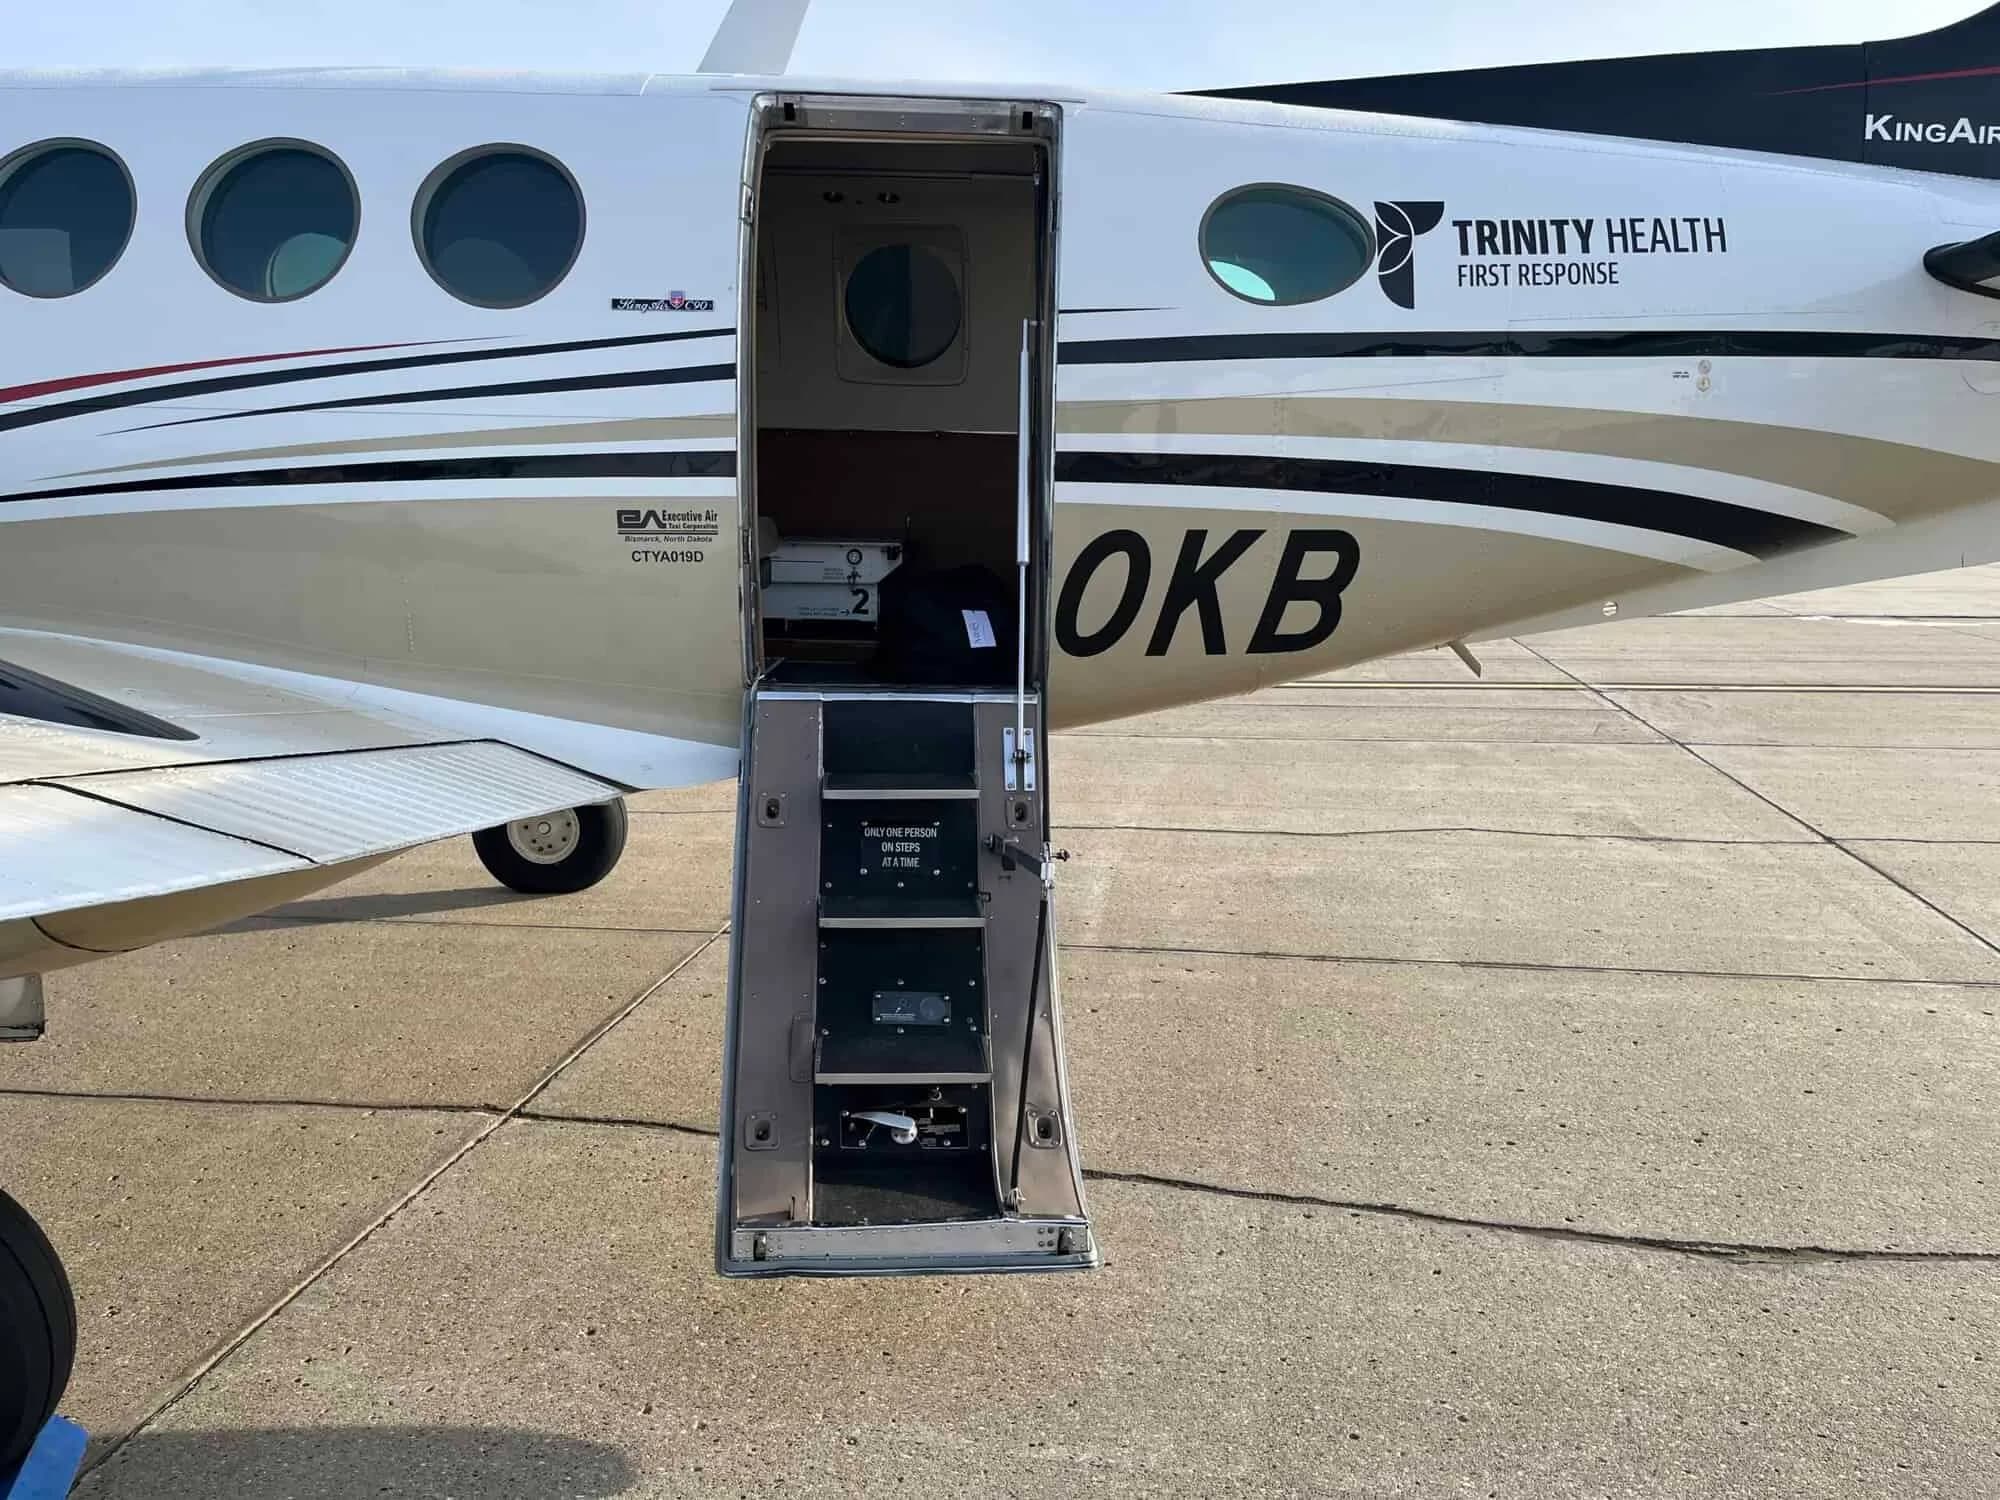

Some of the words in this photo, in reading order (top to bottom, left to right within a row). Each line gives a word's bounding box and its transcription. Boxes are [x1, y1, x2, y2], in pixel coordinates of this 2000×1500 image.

[1452, 217, 1594, 257] TRINITY
[1606, 216, 1728, 253] HEALTH
[1457, 263, 1512, 288] FIRST
[1518, 261, 1620, 287] RESPONSE
[661, 509, 703, 522] Executive
[704, 509, 719, 522] Air
[682, 522, 719, 532] Corporation
[663, 535, 685, 544] North
[686, 535, 713, 544] Dakota
[631, 550, 704, 563] CTYA019D
[851, 588, 870, 615] 2
[864, 826, 886, 838] ONLY
[886, 826, 904, 838] ONE
[904, 826, 938, 838] PERSON
[881, 842, 894, 853] ON
[895, 842, 921, 853] STEPS
[882, 857, 892, 868] AT
[892, 857, 900, 868] A
[900, 857, 920, 868] TIME
